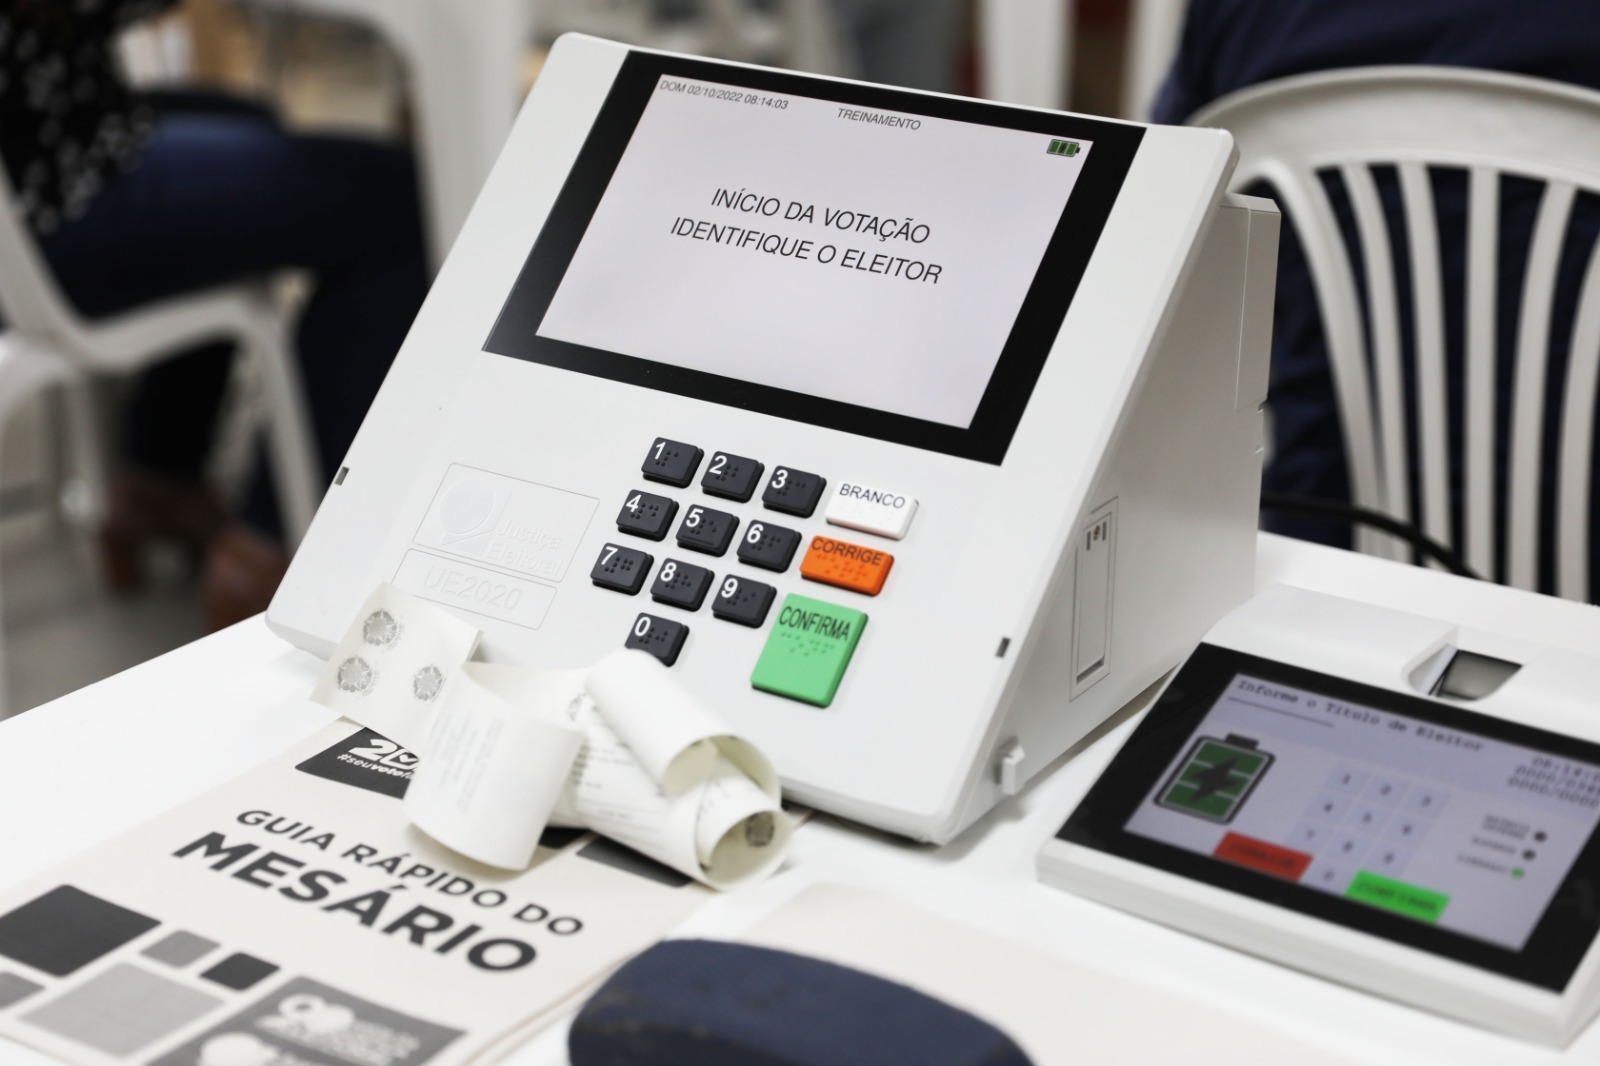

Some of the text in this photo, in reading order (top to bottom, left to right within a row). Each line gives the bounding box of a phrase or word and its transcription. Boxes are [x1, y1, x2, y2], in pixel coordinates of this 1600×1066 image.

[659, 80, 789, 110] DOM 02/10/2022 08:14:03
[837, 108, 921, 131] TREINAMENTO
[711, 187, 930, 243] INÍCIO DA VOTAÇÃO
[671, 216, 943, 284] IDENTIFIQUE O ELEITOR
[653, 441, 666, 460] 1
[709, 456, 727, 474] 2
[771, 469, 789, 489] 3
[626, 494, 642, 513] 4
[838, 483, 906, 509] BRANCO
[686, 508, 703, 527] 5
[746, 523, 764, 544] 6
[601, 546, 618, 565] 7
[811, 537, 884, 566] CORRIGE
[660, 562, 677, 582] 8
[424, 566, 521, 610] UE2020
[721, 578, 738, 599] 9
[634, 616, 651, 637] 0
[778, 605, 851, 642] CONFIRMA
[1236, 679, 1299, 704] Informe
[1415, 726, 1485, 754] Eleitor
[235, 809, 584, 936] GUIA RÁPIDO DO
[171, 830, 538, 973] MESÁRIO
